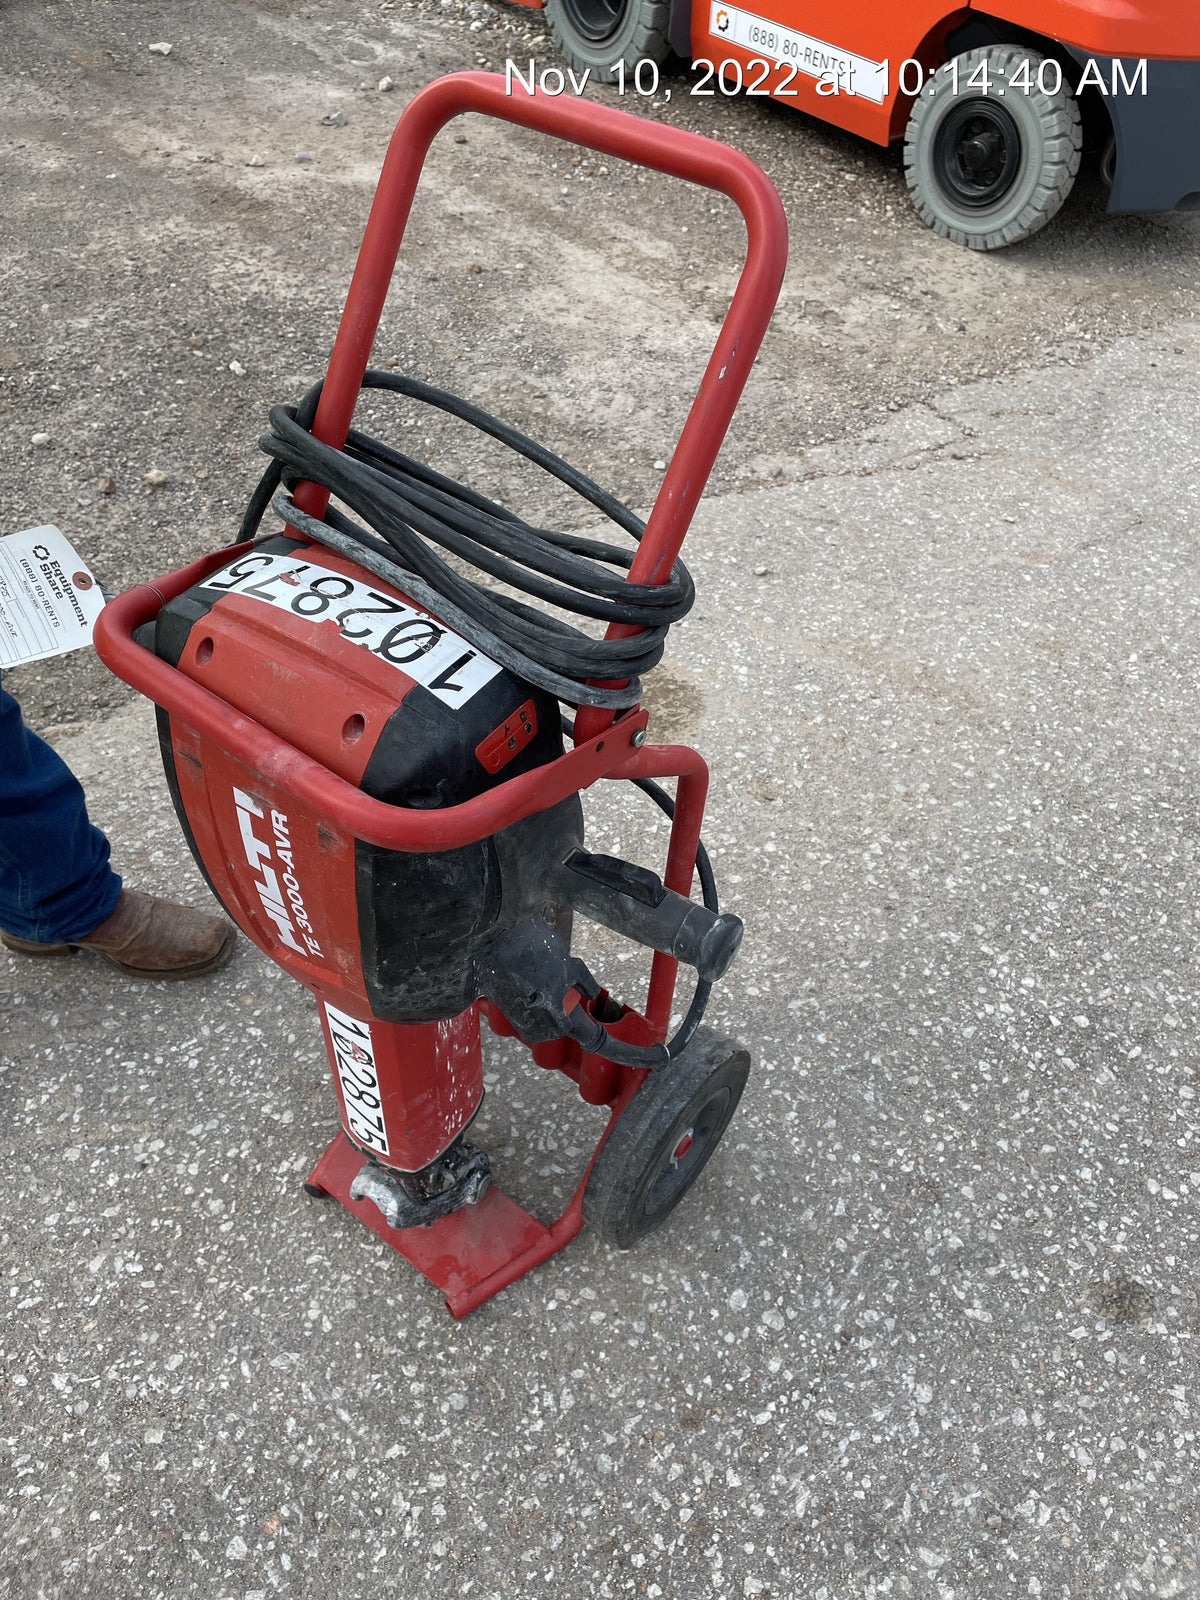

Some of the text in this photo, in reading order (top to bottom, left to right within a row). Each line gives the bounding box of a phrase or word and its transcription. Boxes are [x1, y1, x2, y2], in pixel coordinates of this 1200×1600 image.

[748, 24, 847, 76] (888) 80-RENTS
[19, 558, 38, 583] (888)
[34, 584, 61, 628] 80-RENTS
[39, 563, 64, 600] Share
[49, 559, 88, 628] Equipment
[233, 786, 309, 958] HILTI
[270, 808, 325, 959] TE 3000-AVR
